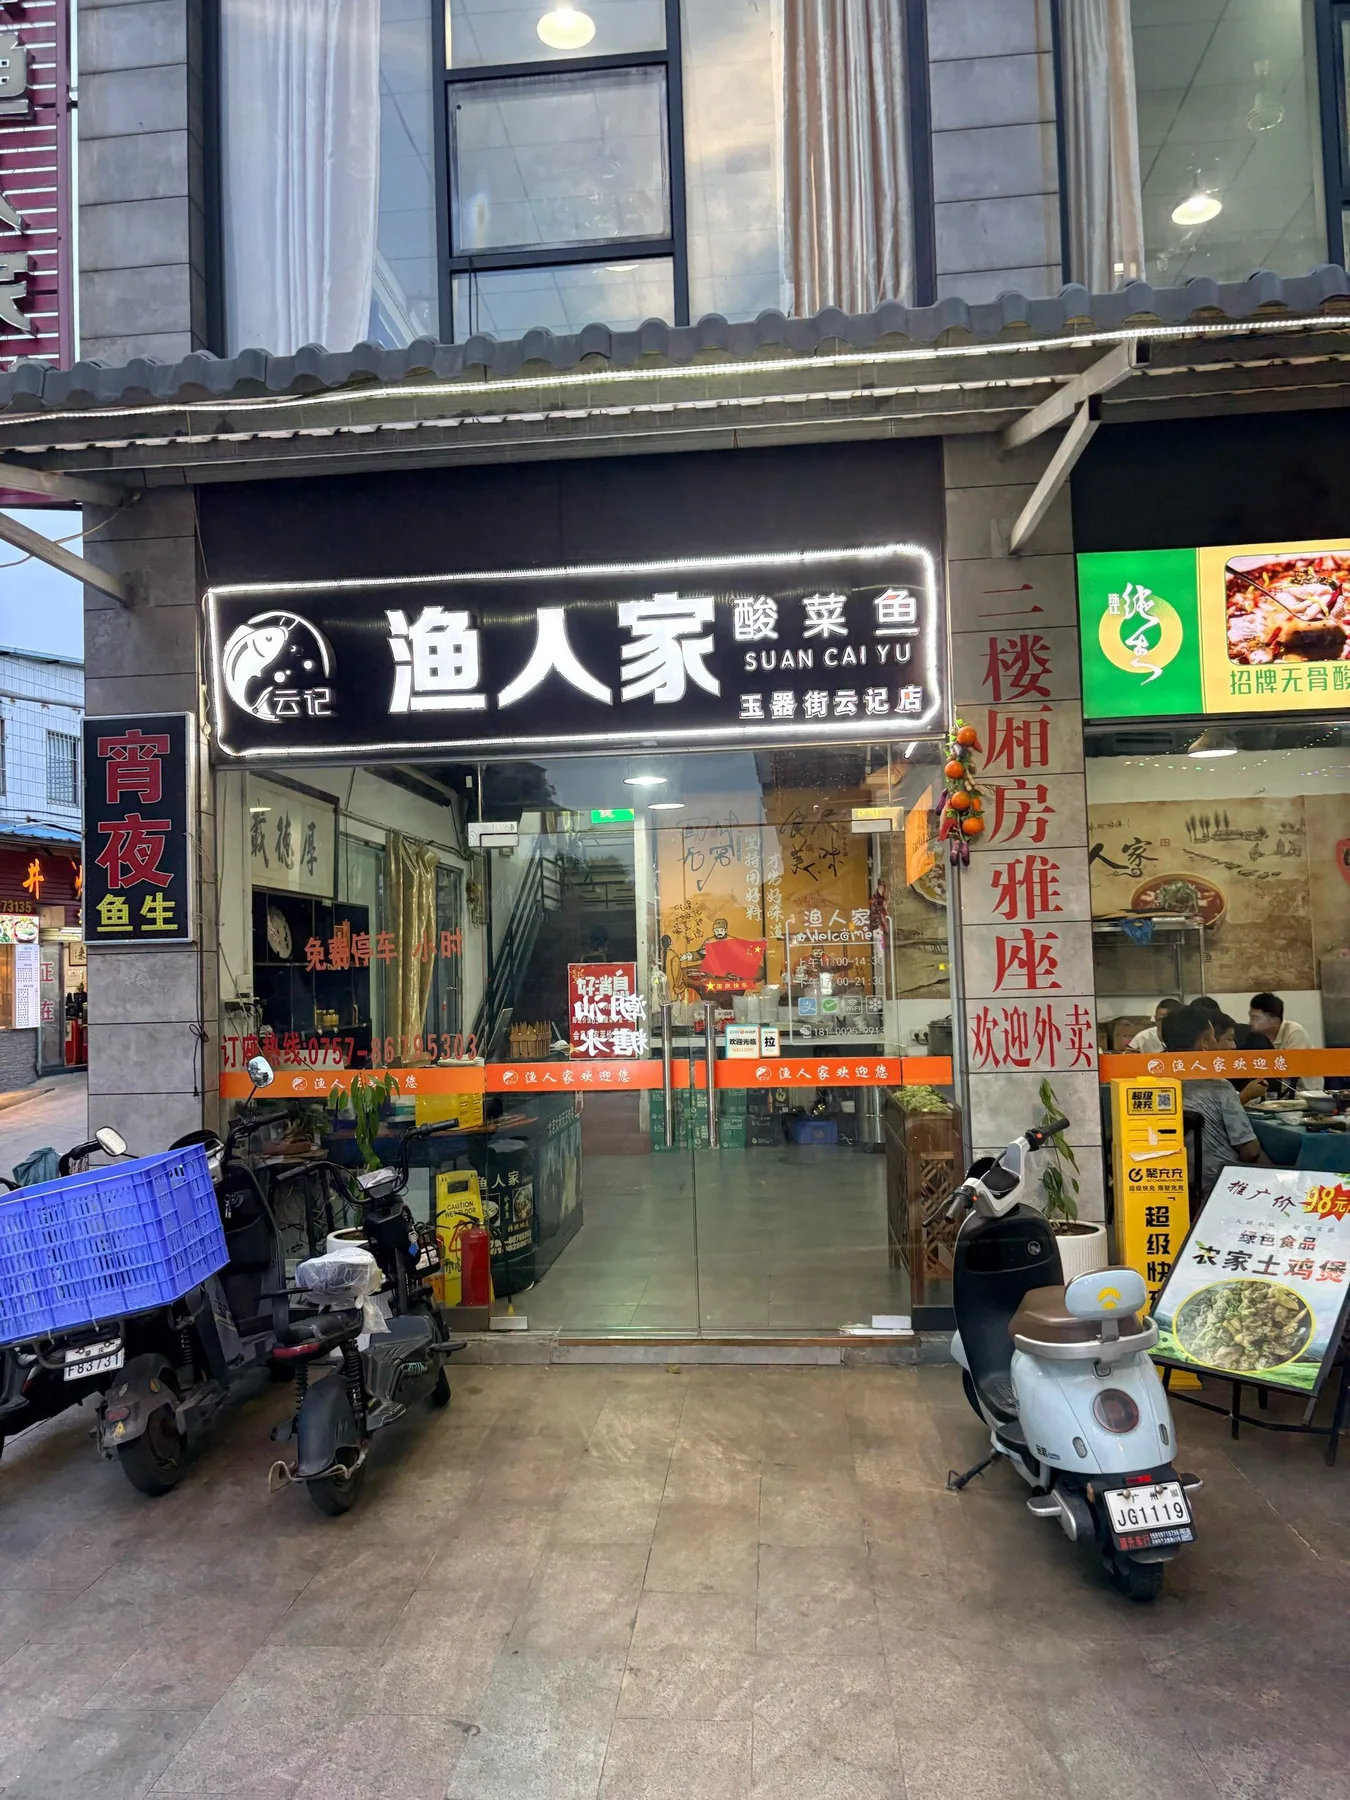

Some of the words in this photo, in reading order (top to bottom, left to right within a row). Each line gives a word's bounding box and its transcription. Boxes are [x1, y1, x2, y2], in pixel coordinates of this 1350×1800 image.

[733, 588, 920, 641] 酸菜鱼
[384, 592, 721, 714] 渔人家
[744, 649, 815, 672] SUAN
[823, 645, 867, 667] CAI
[876, 643, 912, 664] YU
[272, 688, 334, 716] 云记
[739, 685, 923, 720] 玉器街云记店
[978, 583, 1063, 993] 二楼厢房雅座
[96, 729, 174, 889] 宵夜
[0, 900, 32, 913] 73135
[96, 893, 178, 931] 鱼生
[803, 908, 870, 927] 渔人家
[304, 930, 398, 972] 免费停车
[413, 928, 463, 962] 小时
[729, 1038, 757, 1046] 欢迎光临
[764, 1036, 776, 1047] 拉
[970, 1003, 1094, 1070] 欢迎外卖
[525, 1069, 631, 1083] 渔人家欢迎您
[778, 1065, 889, 1079] 渔人家欢迎您
[1171, 1055, 1287, 1072] 渔人家欢迎您
[446, 1200, 474, 1211] CAUTION
[1228, 1180, 1297, 1212] 推广价
[1238, 1229, 1317, 1251] 绿色食品
[1192, 1245, 1348, 1283] 农家土鸡煲
[1117, 1502, 1184, 1527] JG1119
